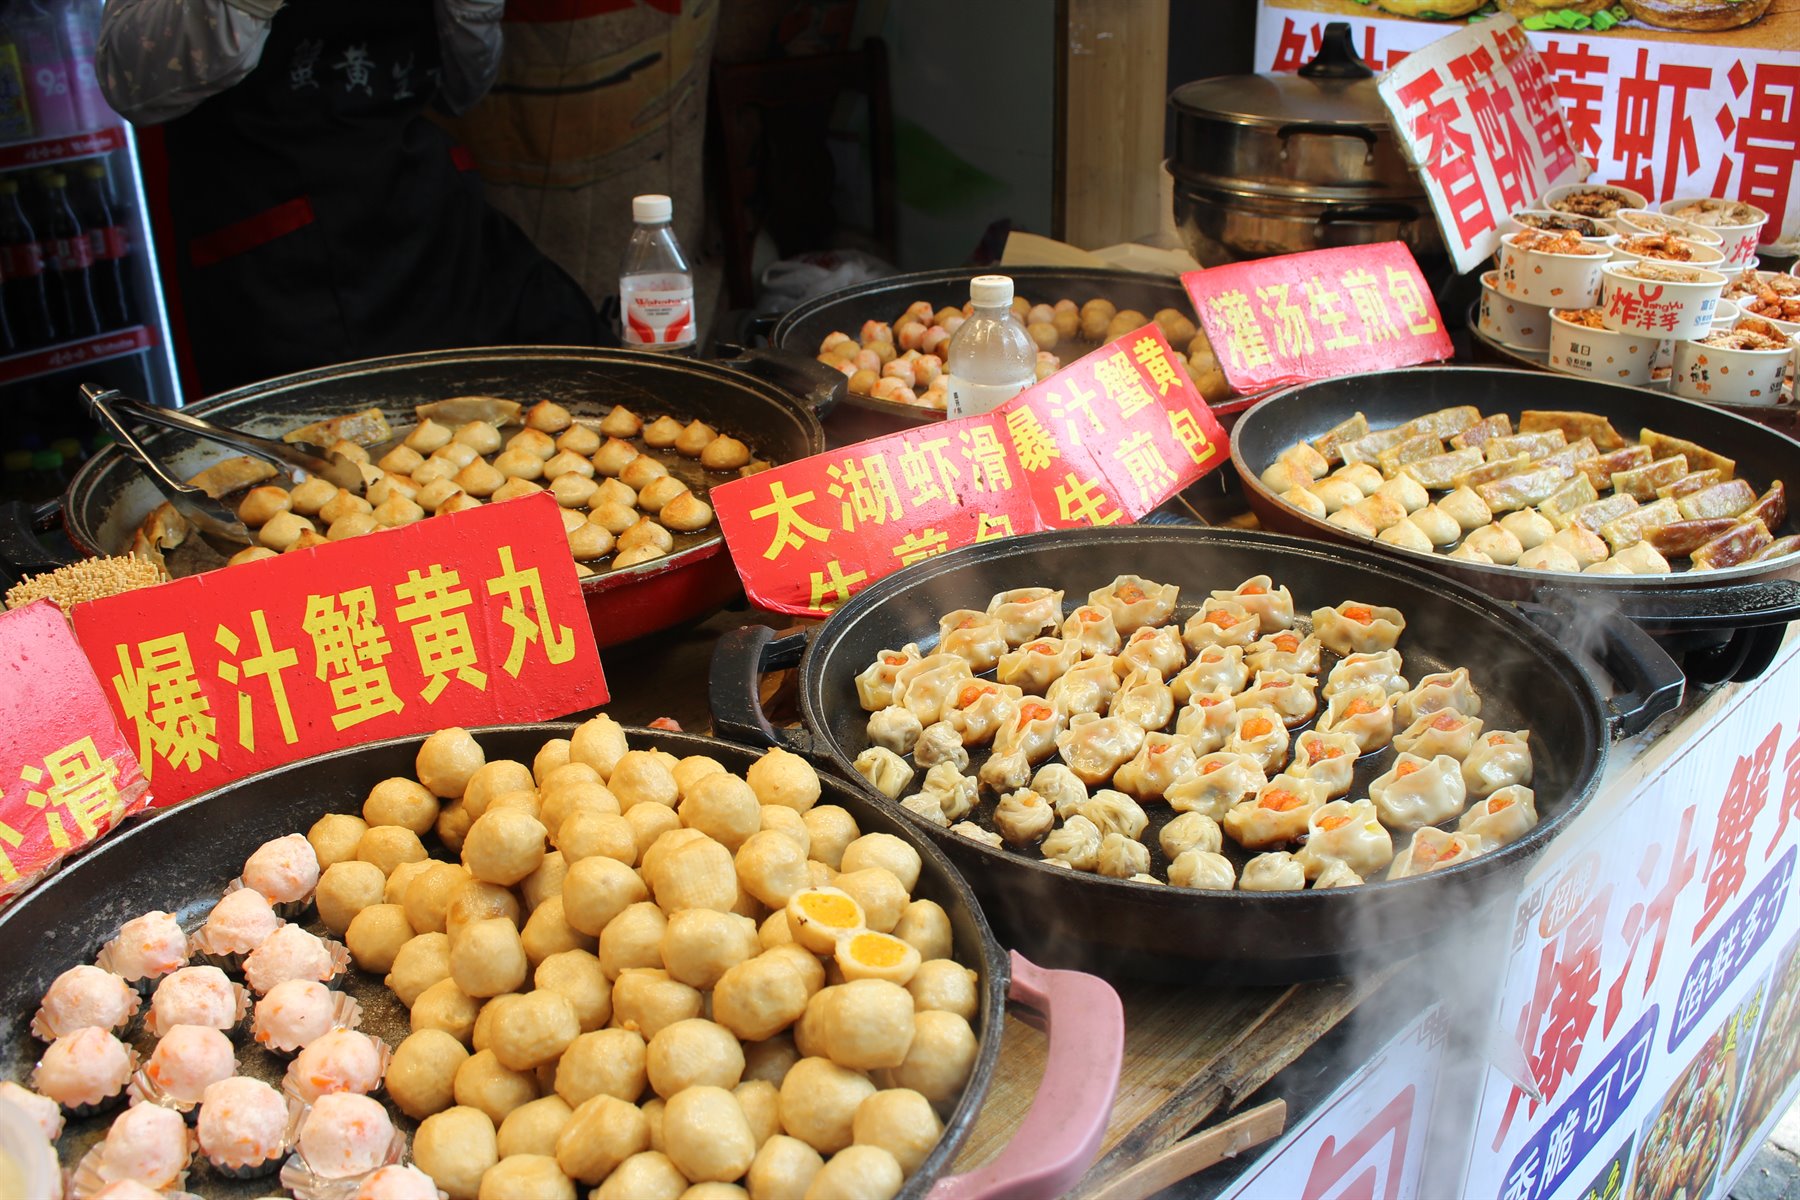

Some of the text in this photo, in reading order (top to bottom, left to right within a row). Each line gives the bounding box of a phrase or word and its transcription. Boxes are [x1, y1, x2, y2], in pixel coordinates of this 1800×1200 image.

[1395, 25, 1577, 250] 香酥蟹
[1207, 265, 1438, 370] 灌汤生煎包
[750, 424, 1013, 561] 太湖虾滑
[1054, 408, 1216, 526] 生煎包
[112, 545, 576, 783] 爆汁蟹黄丸
[1677, 861, 1792, 1037] 馅鲜多汁
